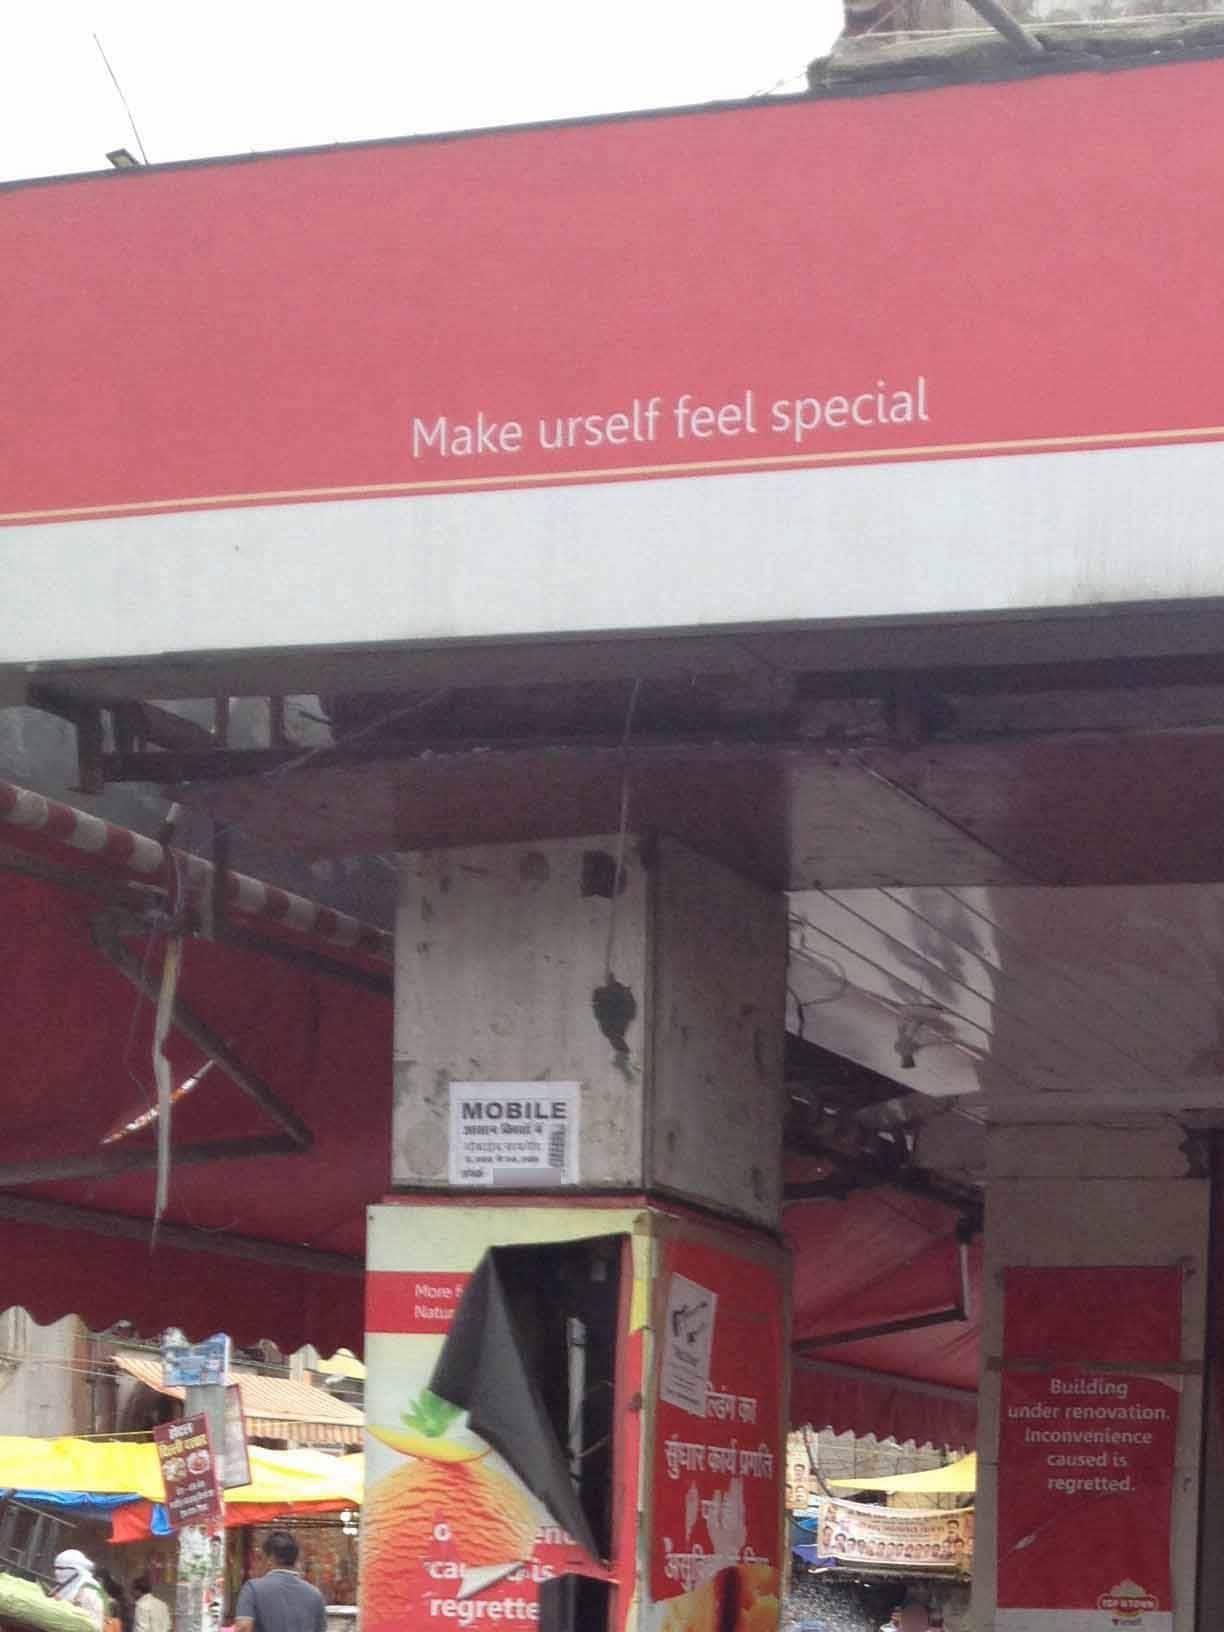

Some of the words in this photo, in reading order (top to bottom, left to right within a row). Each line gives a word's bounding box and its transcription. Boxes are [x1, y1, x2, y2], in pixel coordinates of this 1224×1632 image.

[412, 412, 522, 458] Make
[538, 396, 661, 449] urself
[673, 389, 758, 439] feel
[770, 376, 930, 443] special
[461, 1101, 568, 1120] MOBILE
[1050, 1377, 1128, 1397] Building
[1008, 1403, 1059, 1420] under
[1065, 1404, 1170, 1422] renovation.
[1024, 1428, 1153, 1445] Inconvenience
[1047, 1451, 1107, 1468] caused
[1112, 1452, 1128, 1468] is
[1047, 1476, 1136, 1494] regretted.
